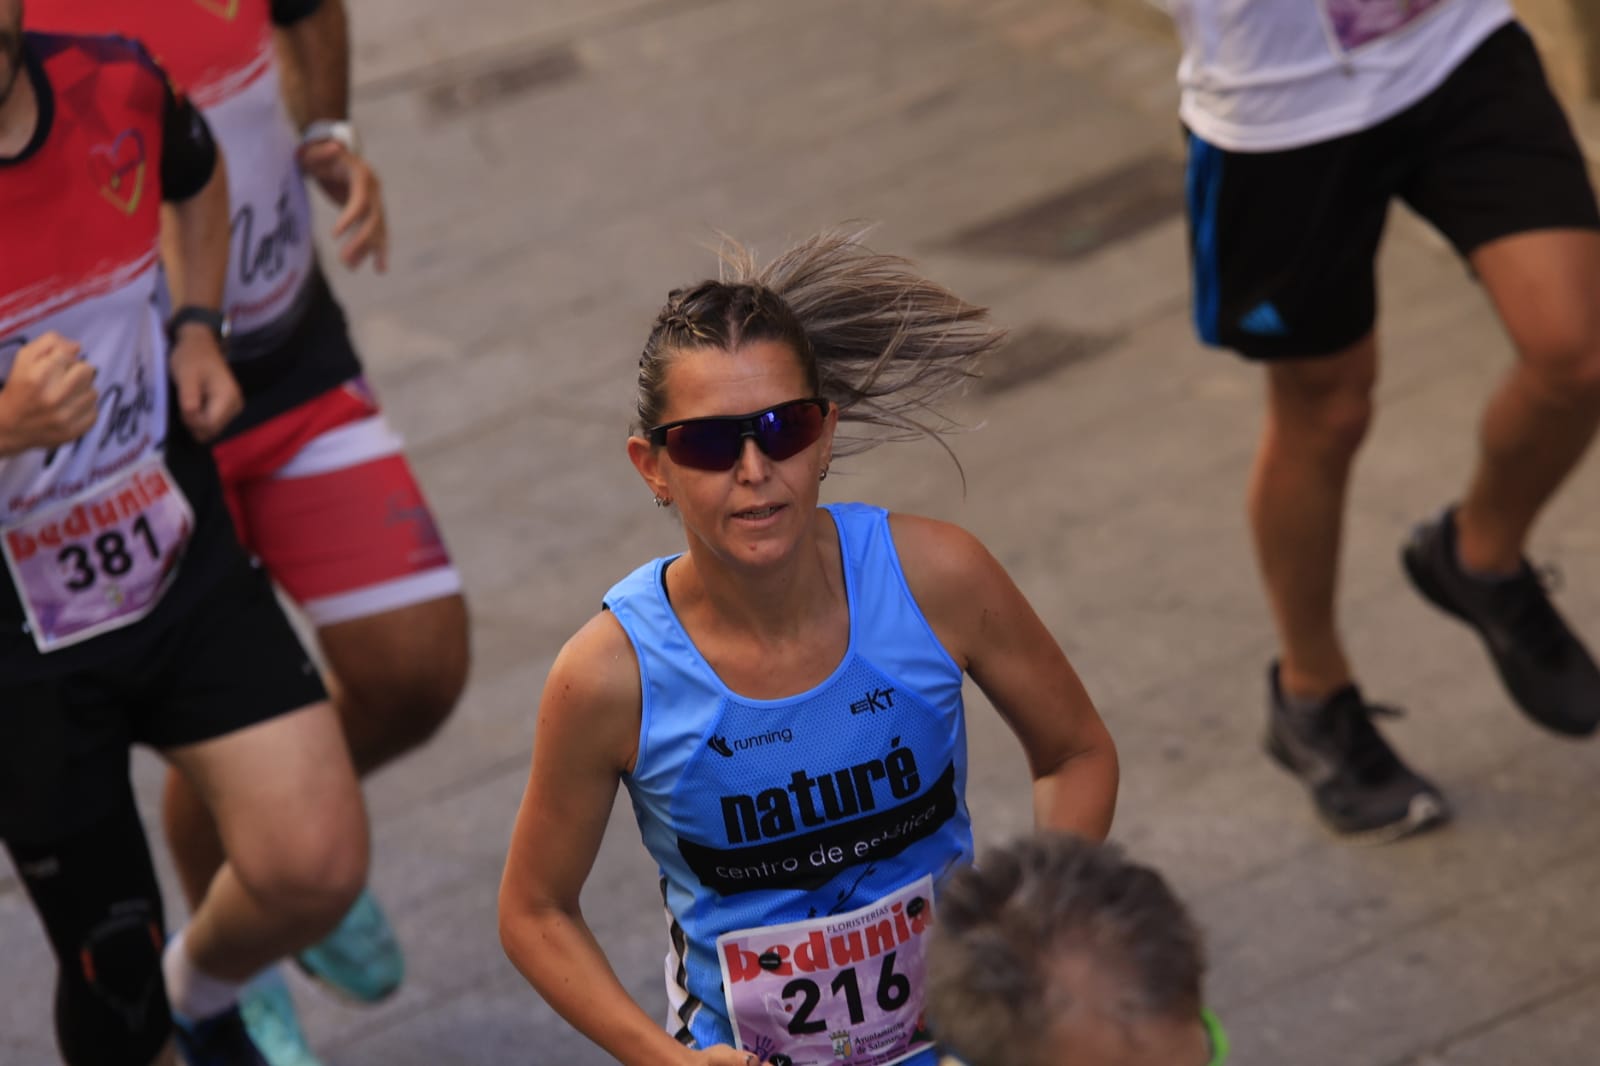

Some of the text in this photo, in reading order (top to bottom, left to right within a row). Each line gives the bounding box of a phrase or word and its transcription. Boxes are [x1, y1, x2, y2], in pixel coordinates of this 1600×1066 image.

[57, 514, 161, 592] 381
[850, 687, 895, 716] EKT
[733, 727, 793, 751] running
[720, 736, 921, 845] naturé
[715, 857, 799, 880] centro
[809, 843, 844, 867] de
[826, 905, 889, 933] FLORISTERÍAS
[781, 951, 911, 1036] 216
[868, 1031, 908, 1051] Salamana
